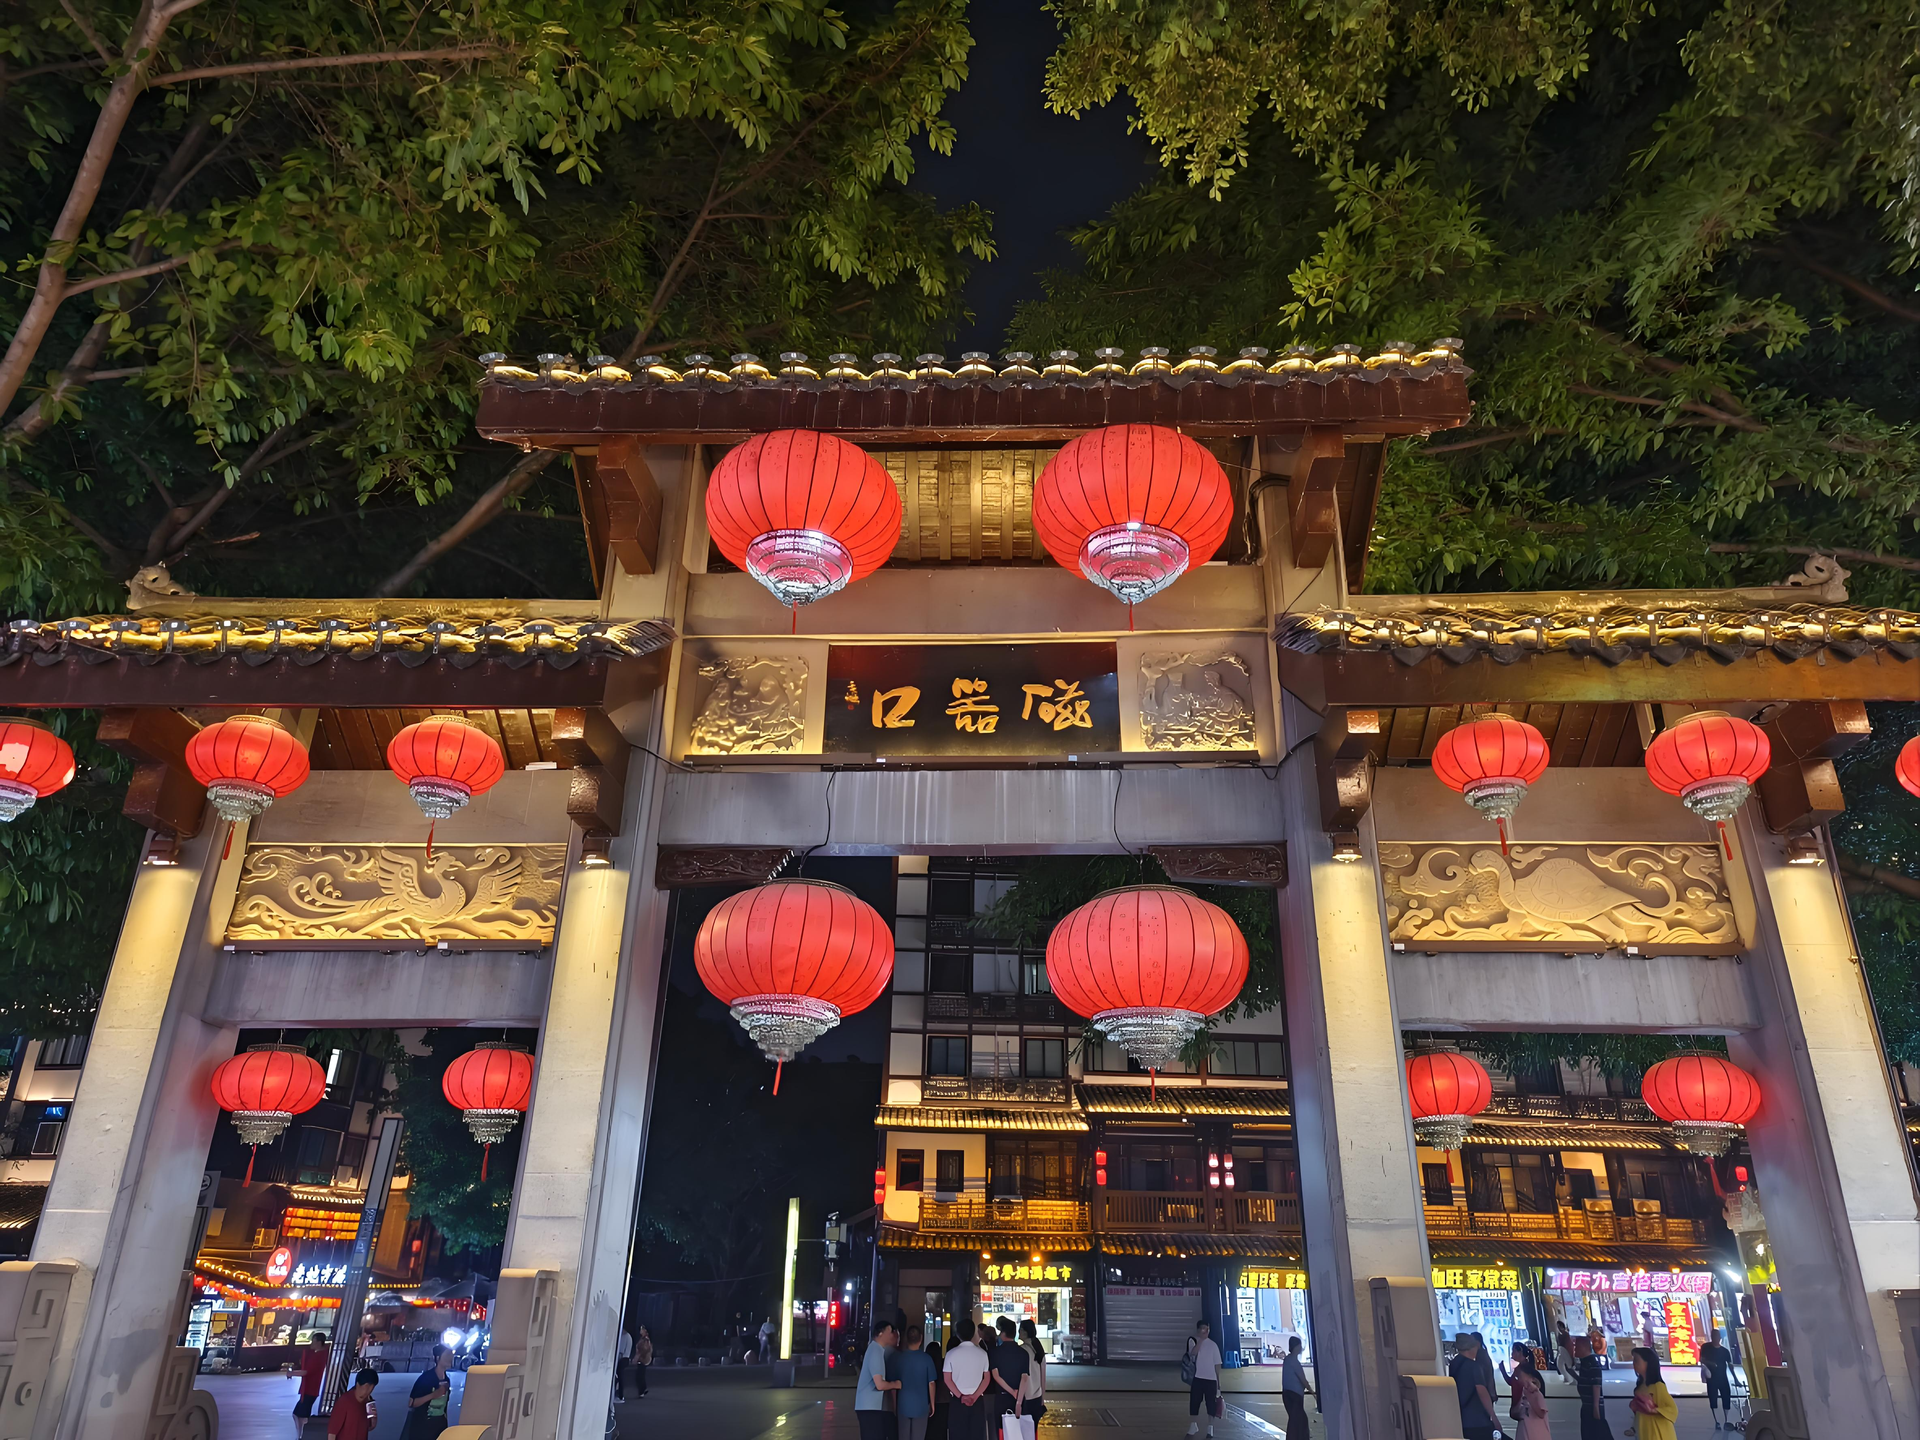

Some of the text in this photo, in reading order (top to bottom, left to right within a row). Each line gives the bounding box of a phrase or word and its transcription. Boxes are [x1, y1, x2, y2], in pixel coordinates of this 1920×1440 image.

[871, 677, 1094, 734] 磁器口
[1466, 1269, 1518, 1290] 家常菜
[1550, 1270, 1712, 1294] 重庆九宫格老火锅
